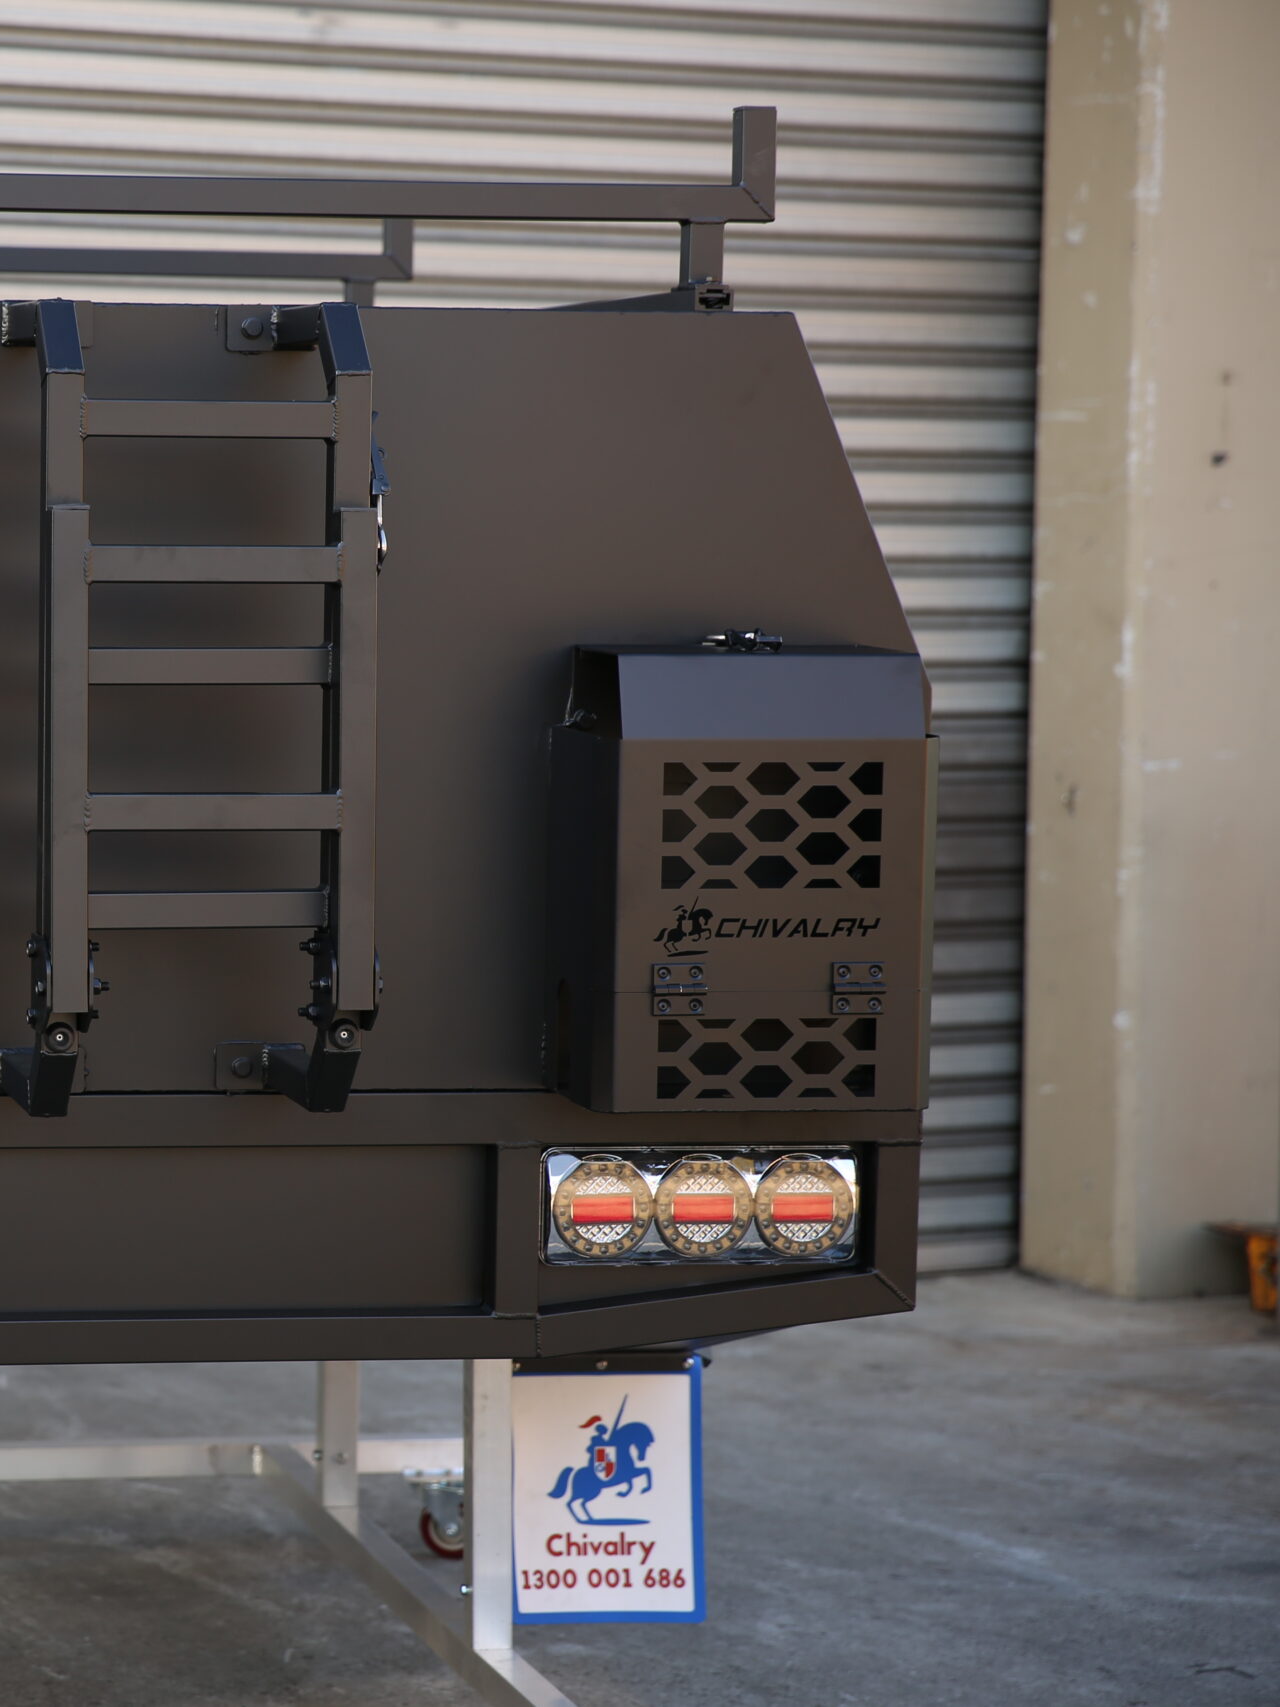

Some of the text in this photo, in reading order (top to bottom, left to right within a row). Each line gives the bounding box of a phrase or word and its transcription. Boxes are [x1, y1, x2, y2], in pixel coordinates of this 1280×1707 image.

[714, 917, 881, 938] CHIVALRY
[545, 1532, 656, 1565] Chivalry
[521, 1568, 686, 1589] 1300 001 686
